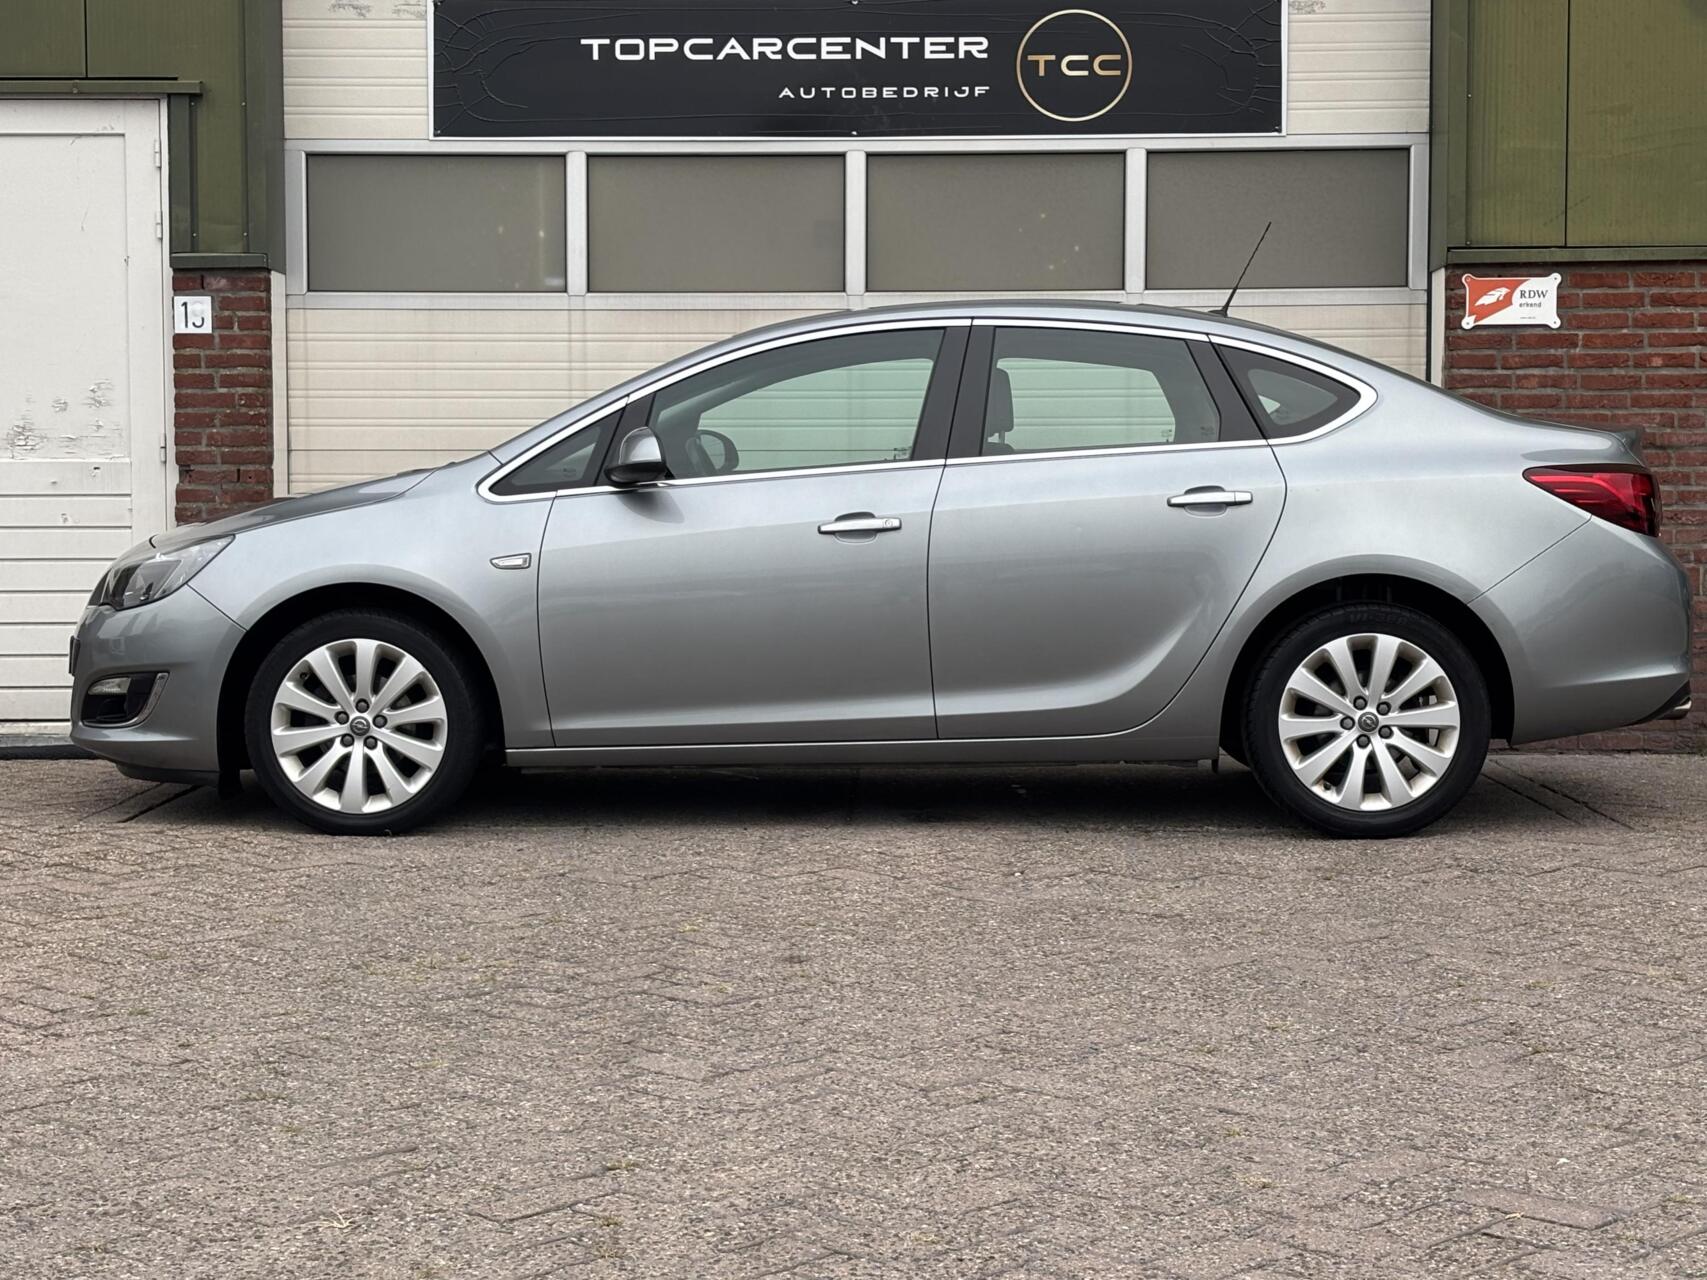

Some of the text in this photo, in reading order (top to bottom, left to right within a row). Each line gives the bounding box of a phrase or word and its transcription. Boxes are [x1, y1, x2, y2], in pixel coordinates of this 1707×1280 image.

[580, 36, 989, 61] TOPCARCENTER
[1027, 54, 1121, 77] TCC
[778, 86, 990, 98] AUTOBEDRIJF
[1519, 289, 1548, 299] RDW
